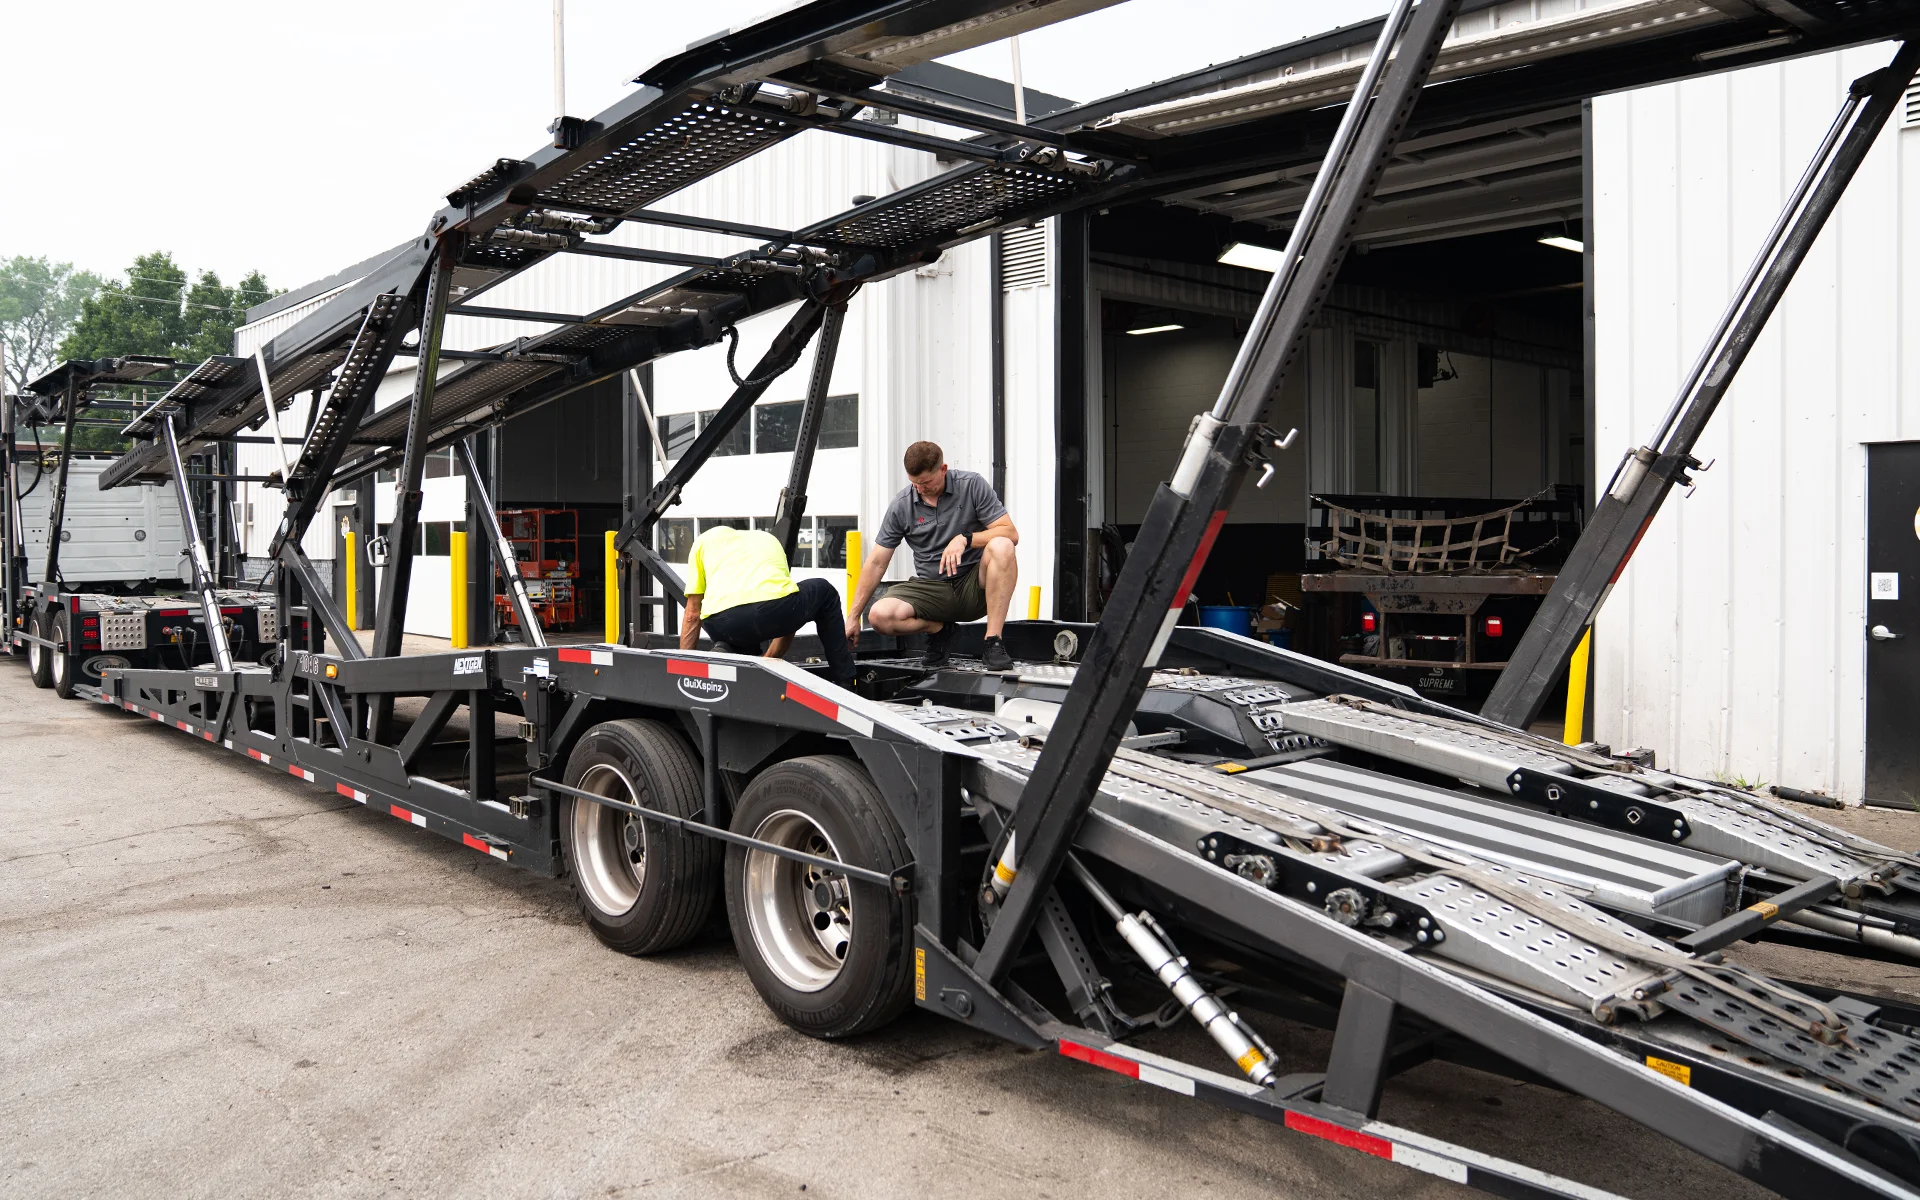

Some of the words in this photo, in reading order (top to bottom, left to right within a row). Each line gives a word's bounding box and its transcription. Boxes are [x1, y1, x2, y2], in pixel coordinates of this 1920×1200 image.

[454, 656, 482, 670] NEXTGEN
[1419, 677, 1454, 689] SUPREME
[916, 949, 924, 971] LIFT
[916, 972, 925, 999] HERE
[1655, 1060, 1681, 1071] CAUTION
